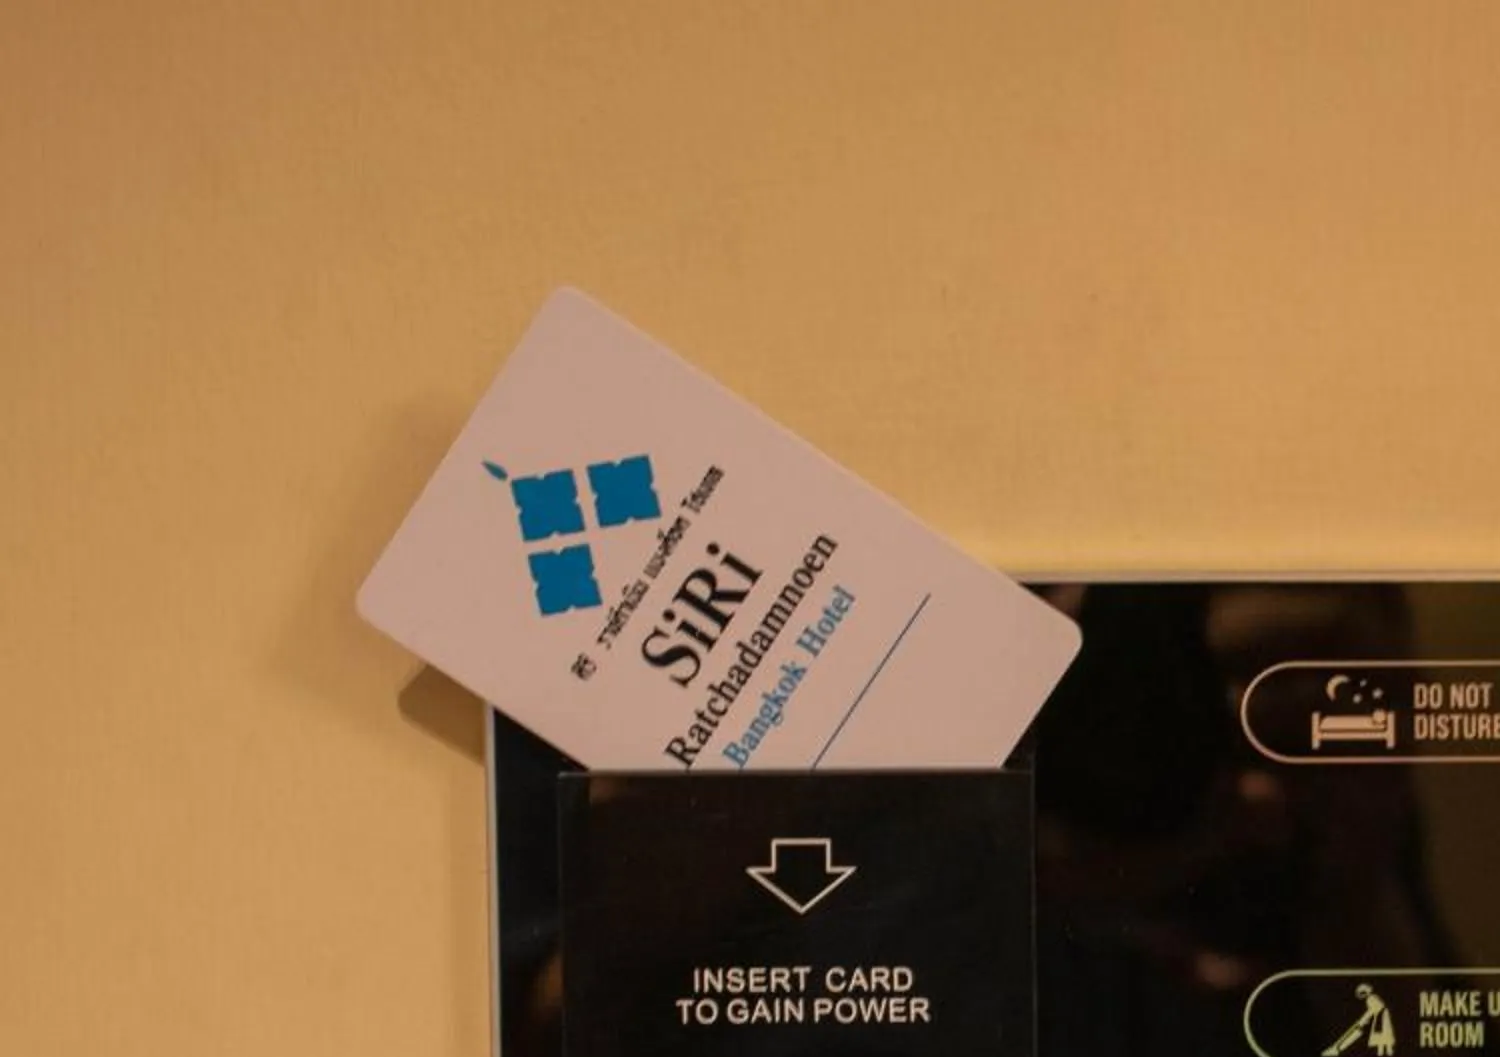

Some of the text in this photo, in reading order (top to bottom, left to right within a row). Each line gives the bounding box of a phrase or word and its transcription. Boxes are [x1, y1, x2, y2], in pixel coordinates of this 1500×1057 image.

[641, 541, 764, 689] SiRi
[664, 532, 838, 772] Ratchadamnoen
[722, 585, 857, 770] Bangkok Hotel
[1414, 682, 1493, 709] DO NOT
[693, 966, 914, 994] INSERT CARD
[676, 997, 931, 1025] TO GAIN POWER
[1419, 992, 1481, 1018] MAKE
[1420, 1022, 1484, 1048] ROOM
